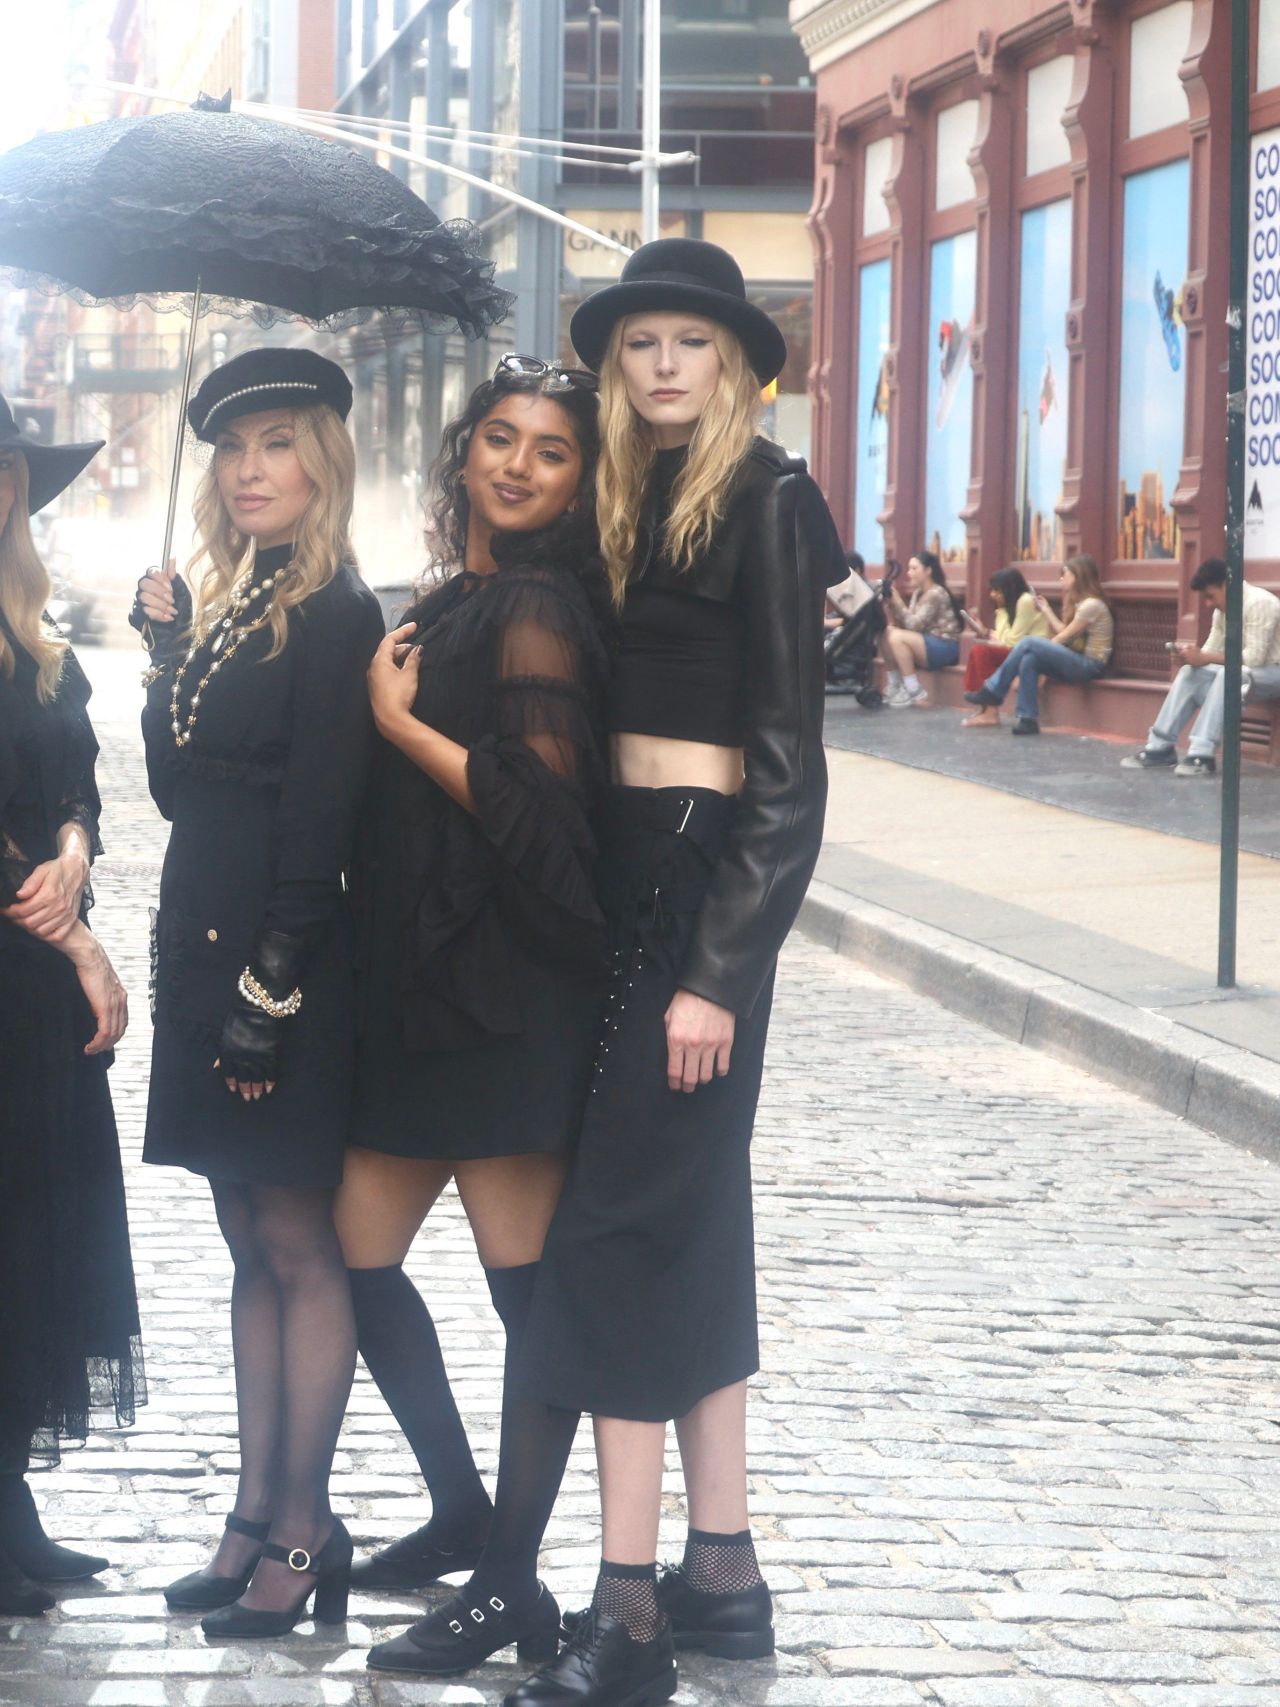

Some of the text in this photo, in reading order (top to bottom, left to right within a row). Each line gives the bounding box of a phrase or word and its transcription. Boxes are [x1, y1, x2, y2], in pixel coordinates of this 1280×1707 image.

[1254, 186, 1280, 221] SO
[1253, 227, 1280, 262] CO
[1252, 268, 1280, 303] SO
[1251, 309, 1280, 344] CO
